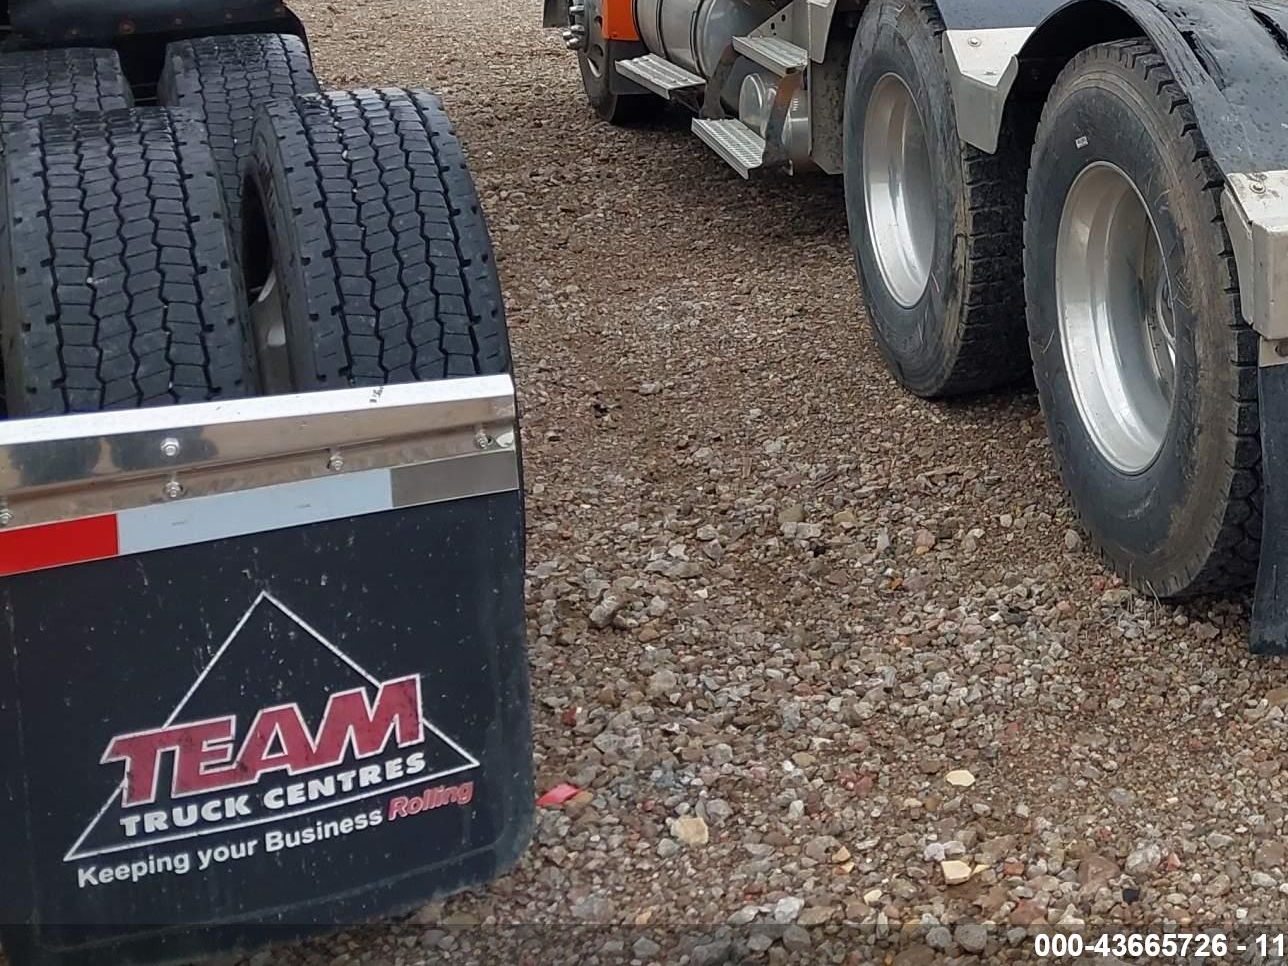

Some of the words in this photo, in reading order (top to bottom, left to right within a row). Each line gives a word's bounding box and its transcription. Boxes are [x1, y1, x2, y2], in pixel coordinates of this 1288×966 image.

[100, 674, 424, 808] TEAM
[120, 794, 251, 836] TRUCK
[263, 752, 426, 810] CENTRES
[77, 848, 190, 889] Keeping
[197, 837, 258, 871] your
[265, 807, 383, 853] Business
[388, 780, 474, 822] Rolling
